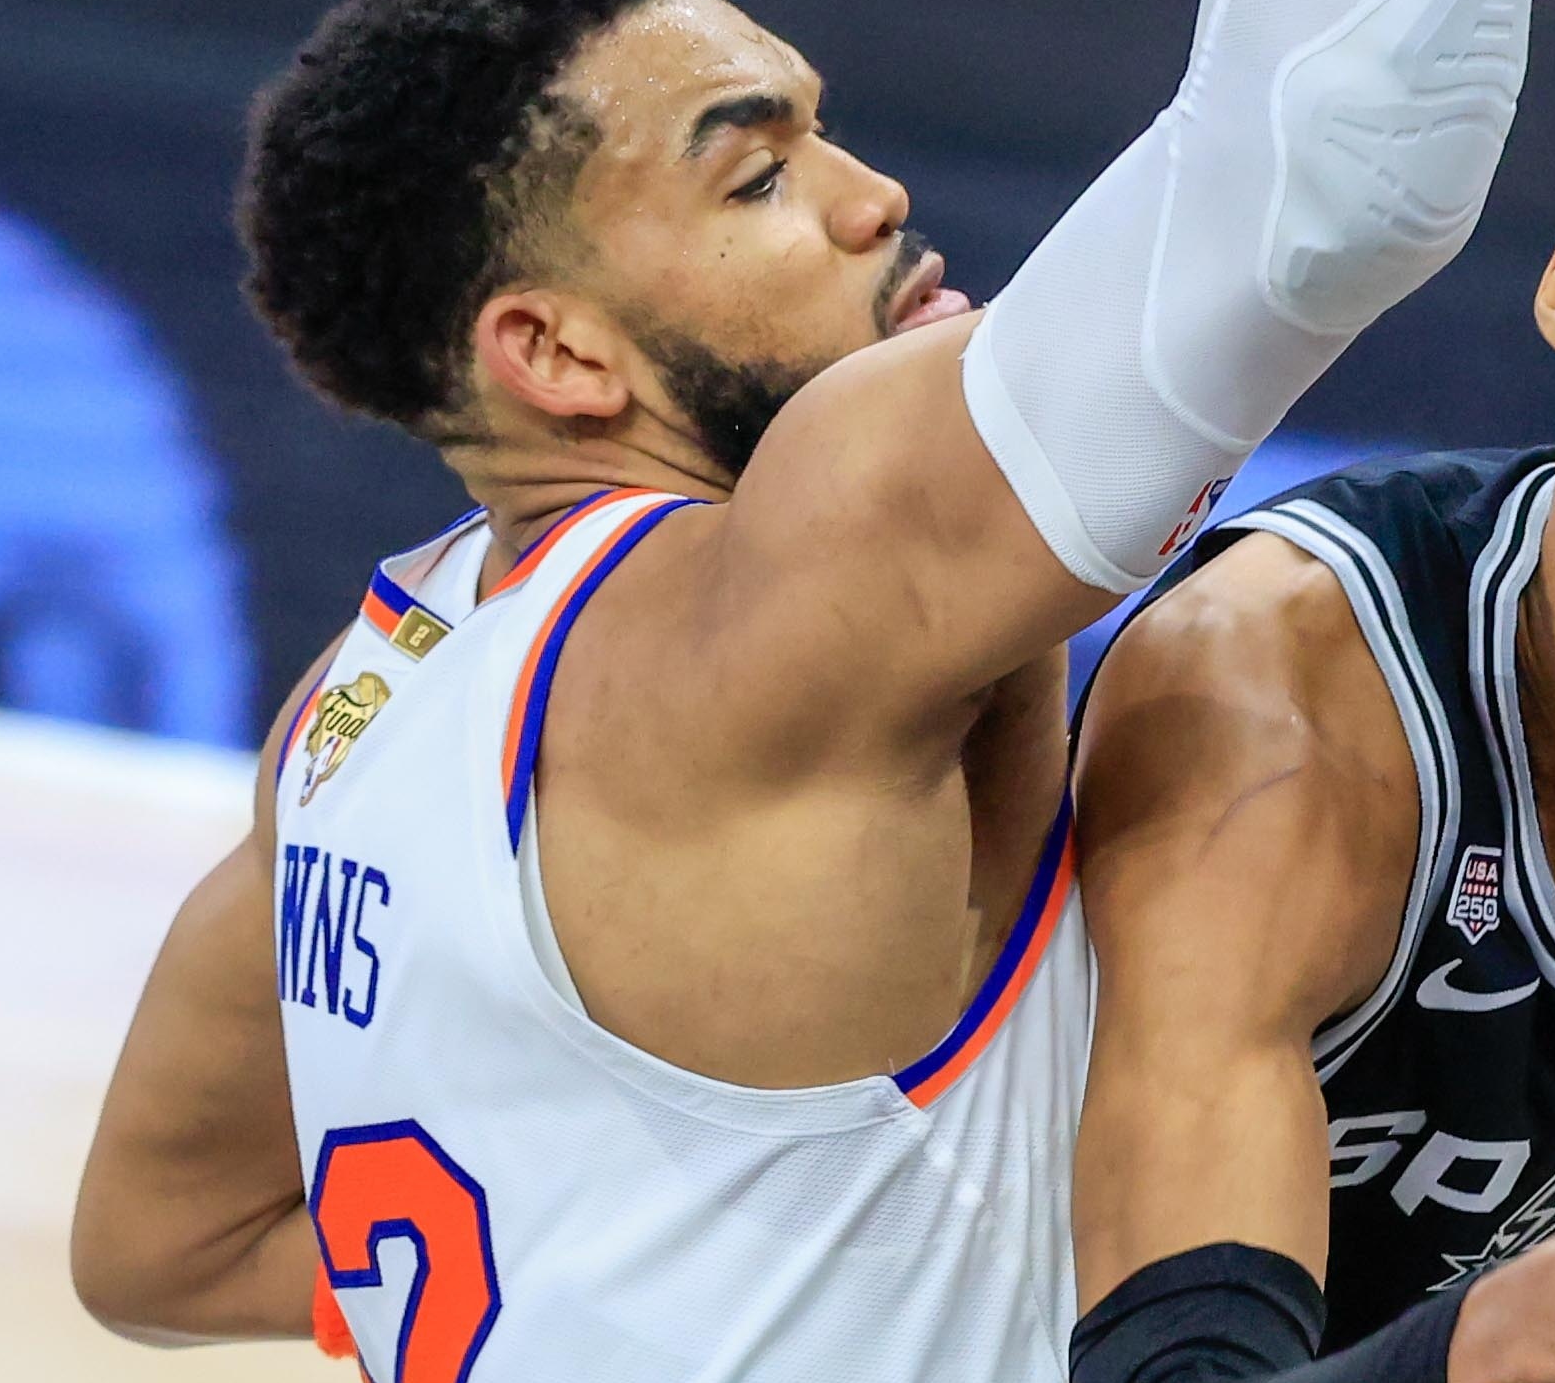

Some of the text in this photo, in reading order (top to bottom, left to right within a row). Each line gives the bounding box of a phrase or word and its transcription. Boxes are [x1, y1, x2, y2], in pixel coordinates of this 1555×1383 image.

[308, 690, 373, 740] Fina
[1465, 859, 1498, 883] USA
[1455, 895, 1498, 922] 250
[279, 843, 391, 1029] WNS
